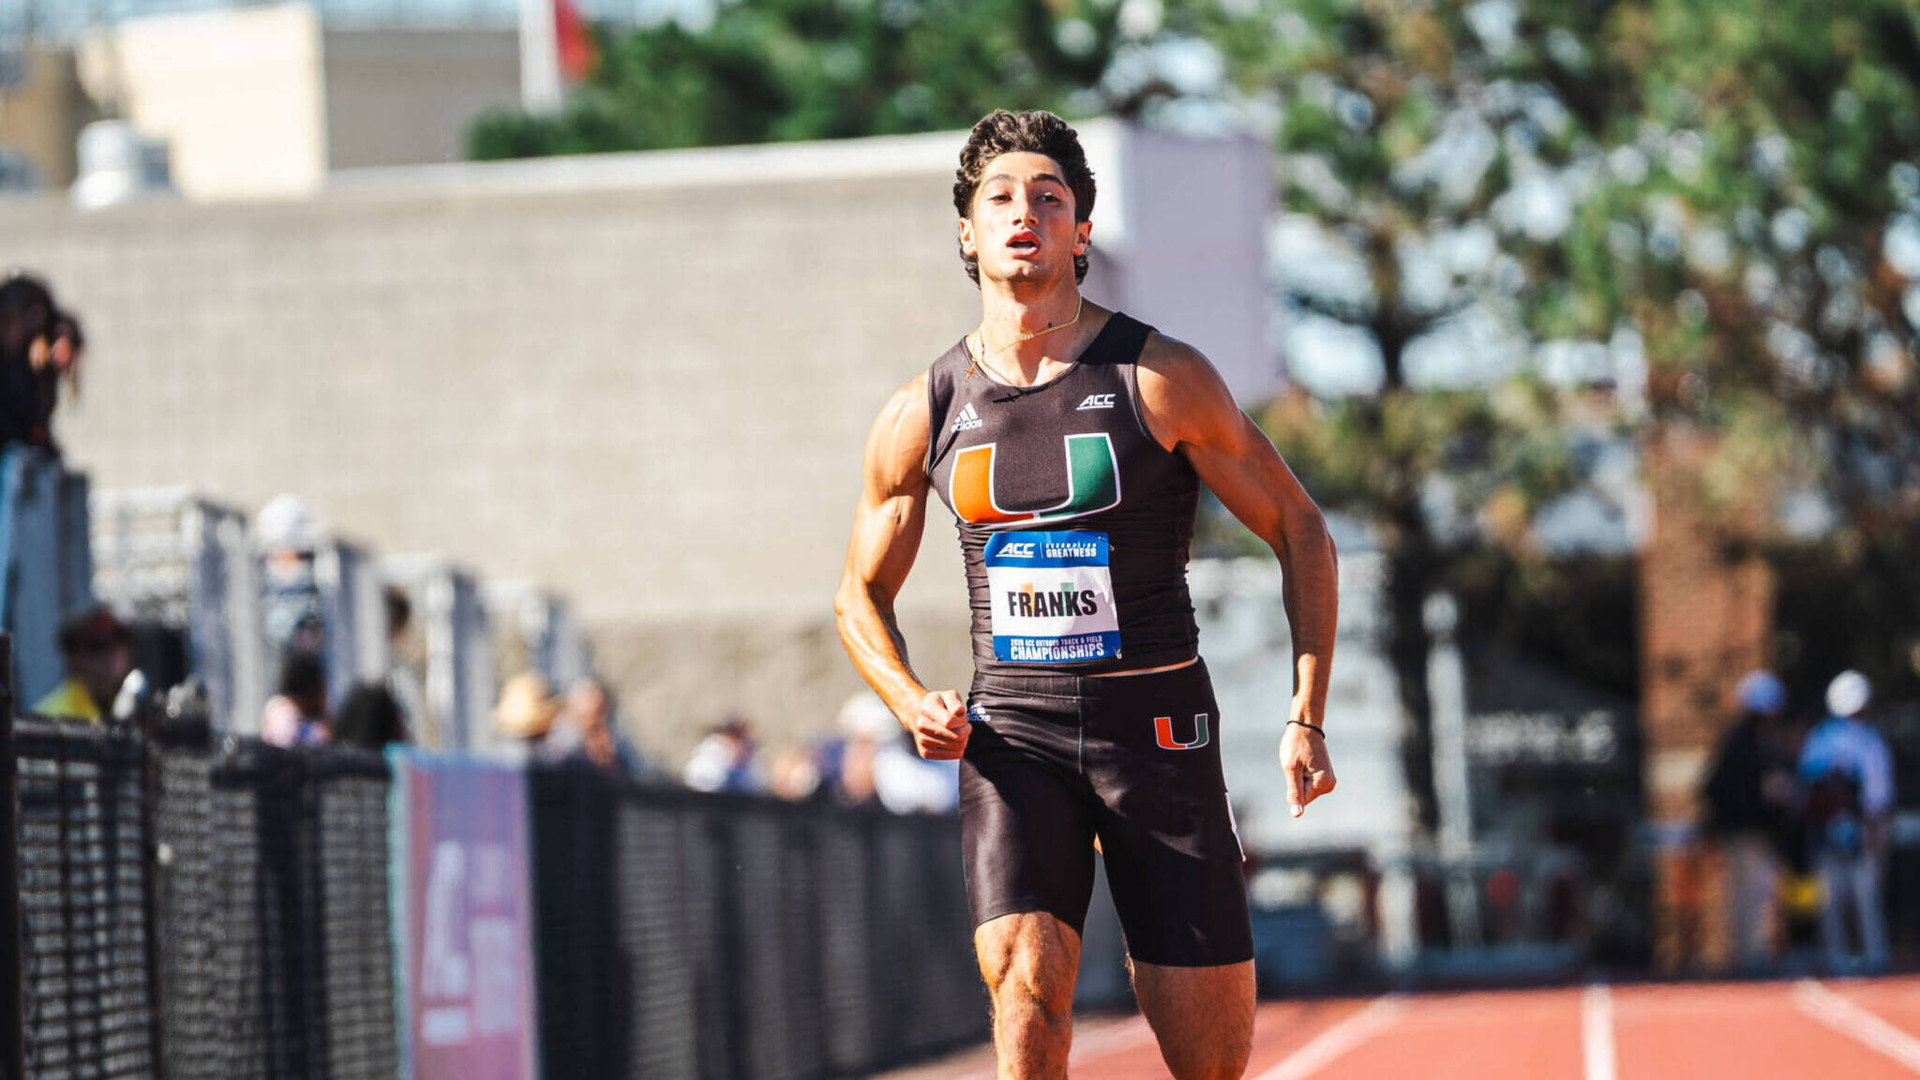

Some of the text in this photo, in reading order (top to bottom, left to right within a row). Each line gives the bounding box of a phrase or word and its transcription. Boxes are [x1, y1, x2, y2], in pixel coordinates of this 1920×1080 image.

[1077, 393, 1116, 409] ACC
[948, 432, 1122, 527] U
[997, 542, 1036, 557] ACC
[1046, 548, 1097, 558] GREATNESS
[1007, 590, 1098, 617] FRANKS
[1060, 637, 1079, 646] TRACK
[1086, 635, 1103, 644] FIELD
[1010, 642, 1105, 661] CHAMPIONSHIPS
